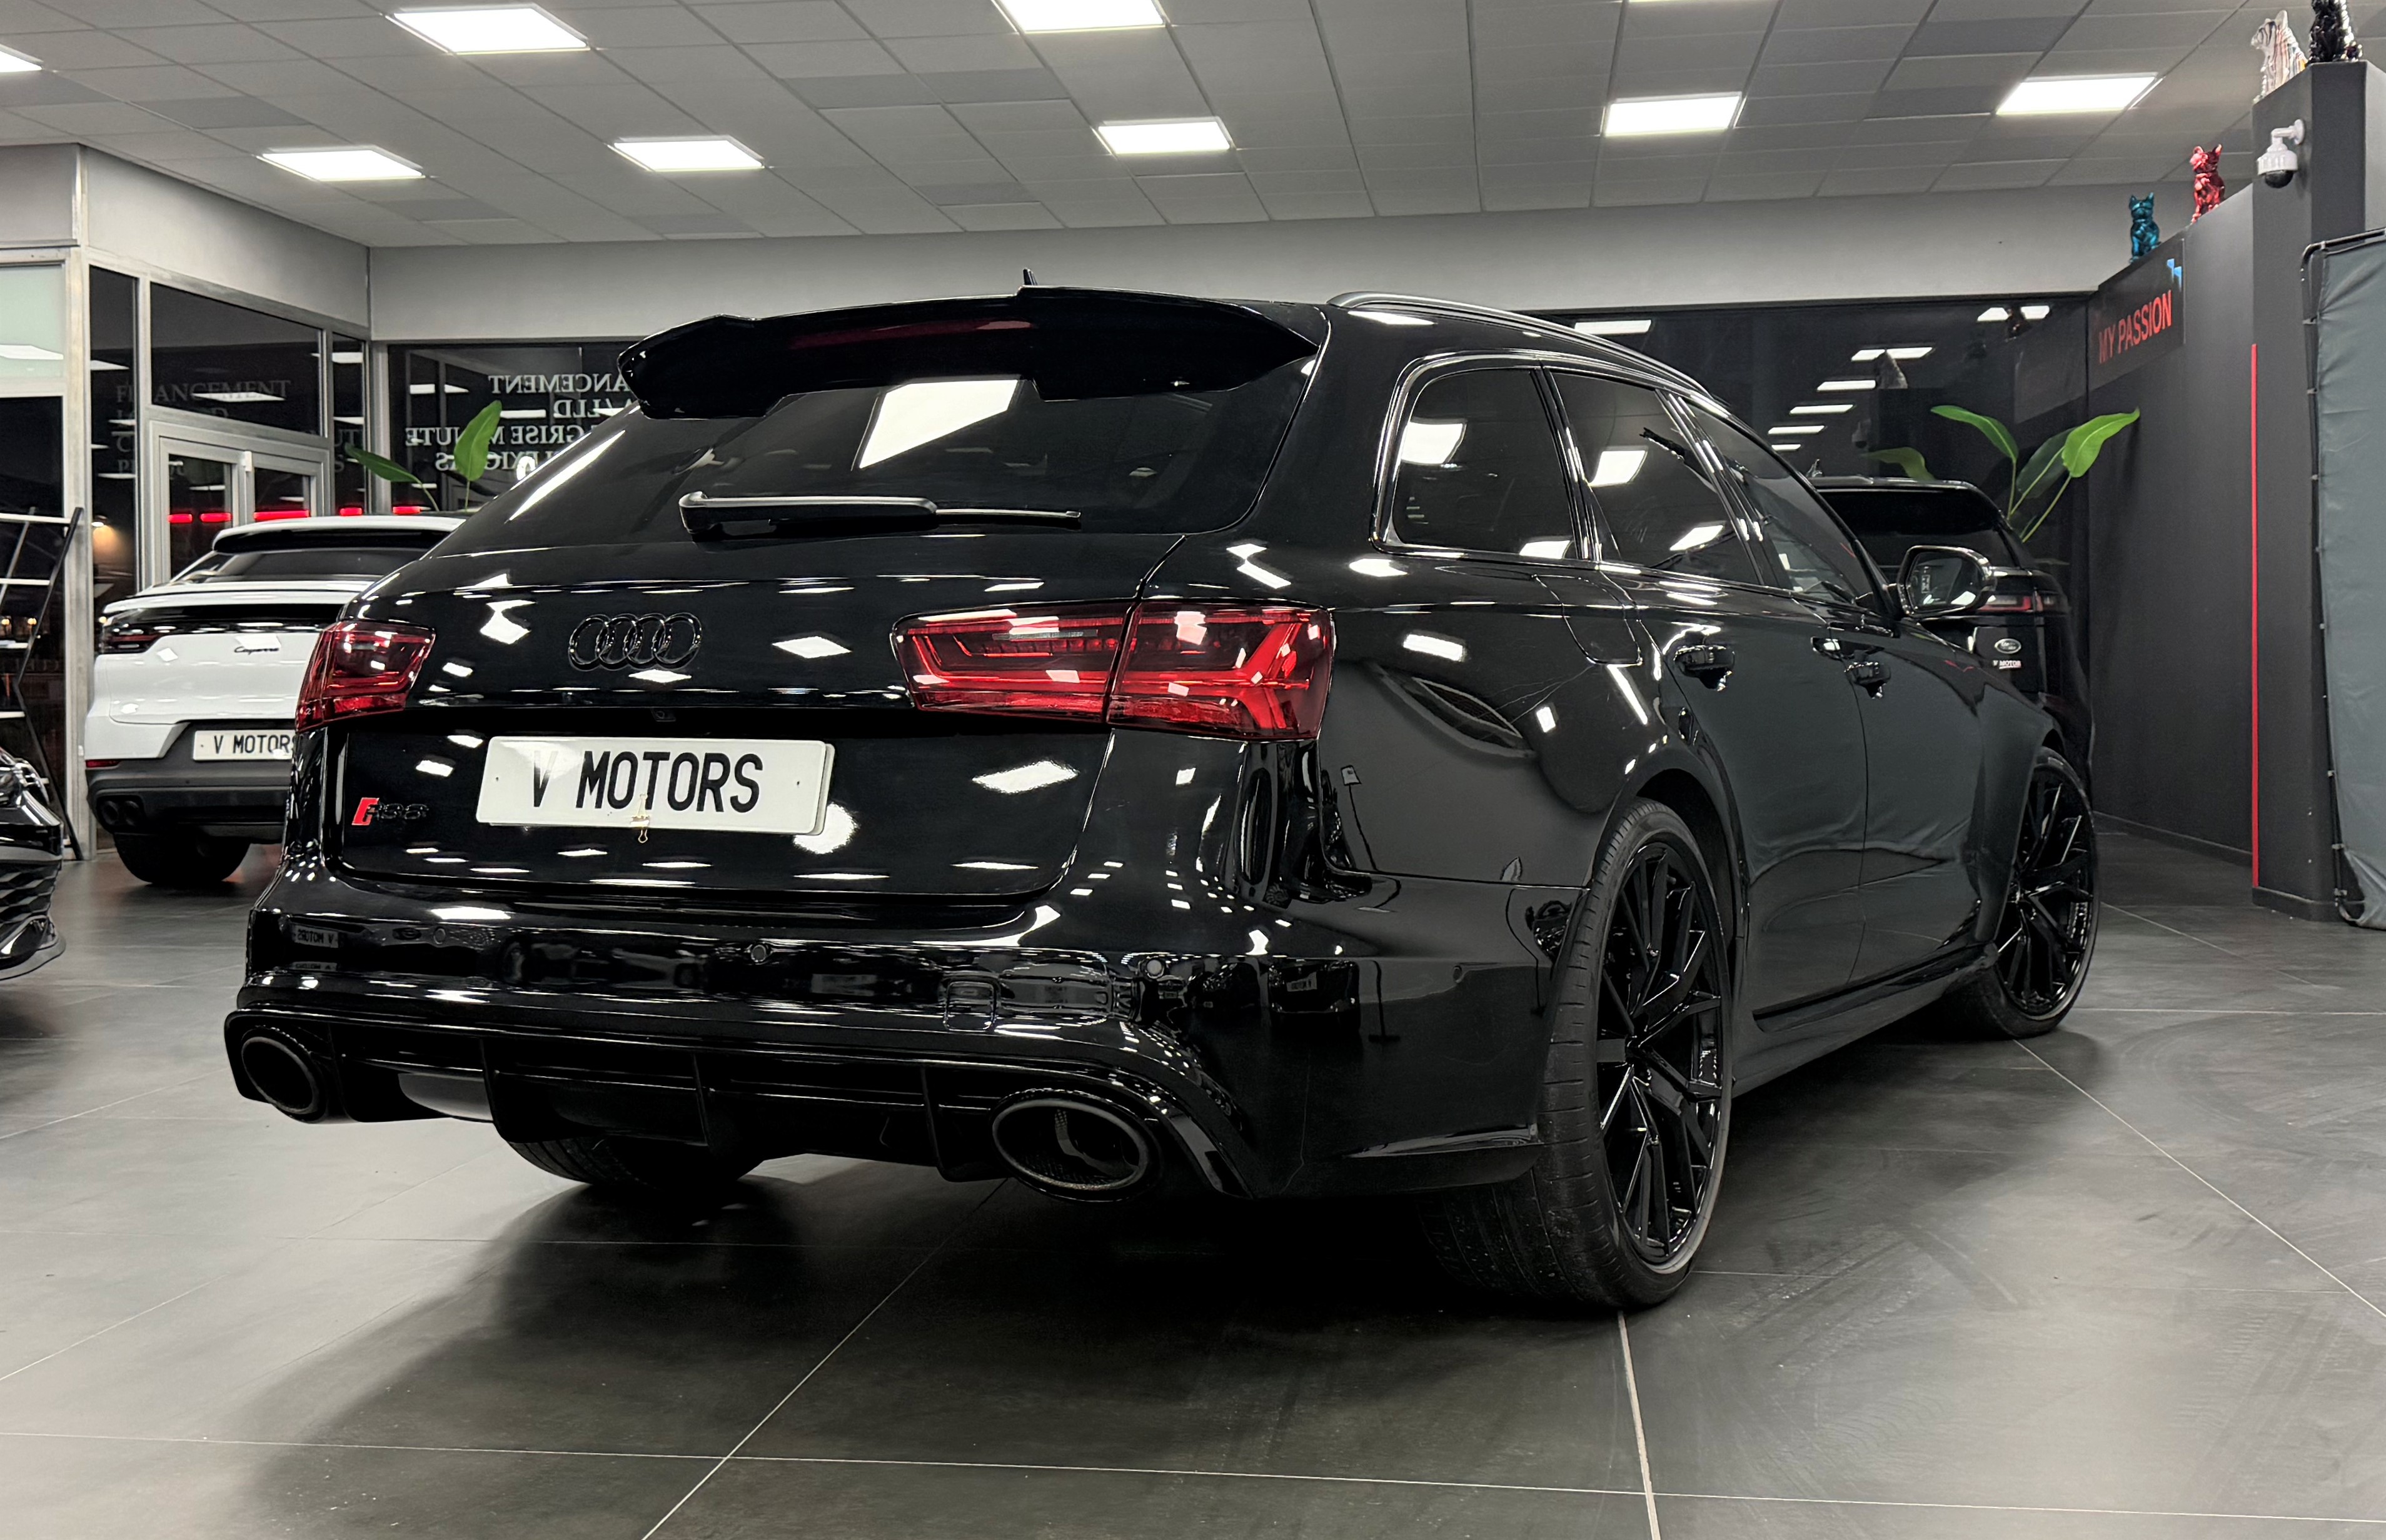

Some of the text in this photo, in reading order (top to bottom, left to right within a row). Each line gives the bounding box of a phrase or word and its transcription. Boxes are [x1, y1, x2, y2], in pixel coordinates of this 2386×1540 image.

[2099, 289, 2172, 363] MY PASSION
[214, 735, 224, 754] V
[533, 750, 763, 813] V MOTORS
